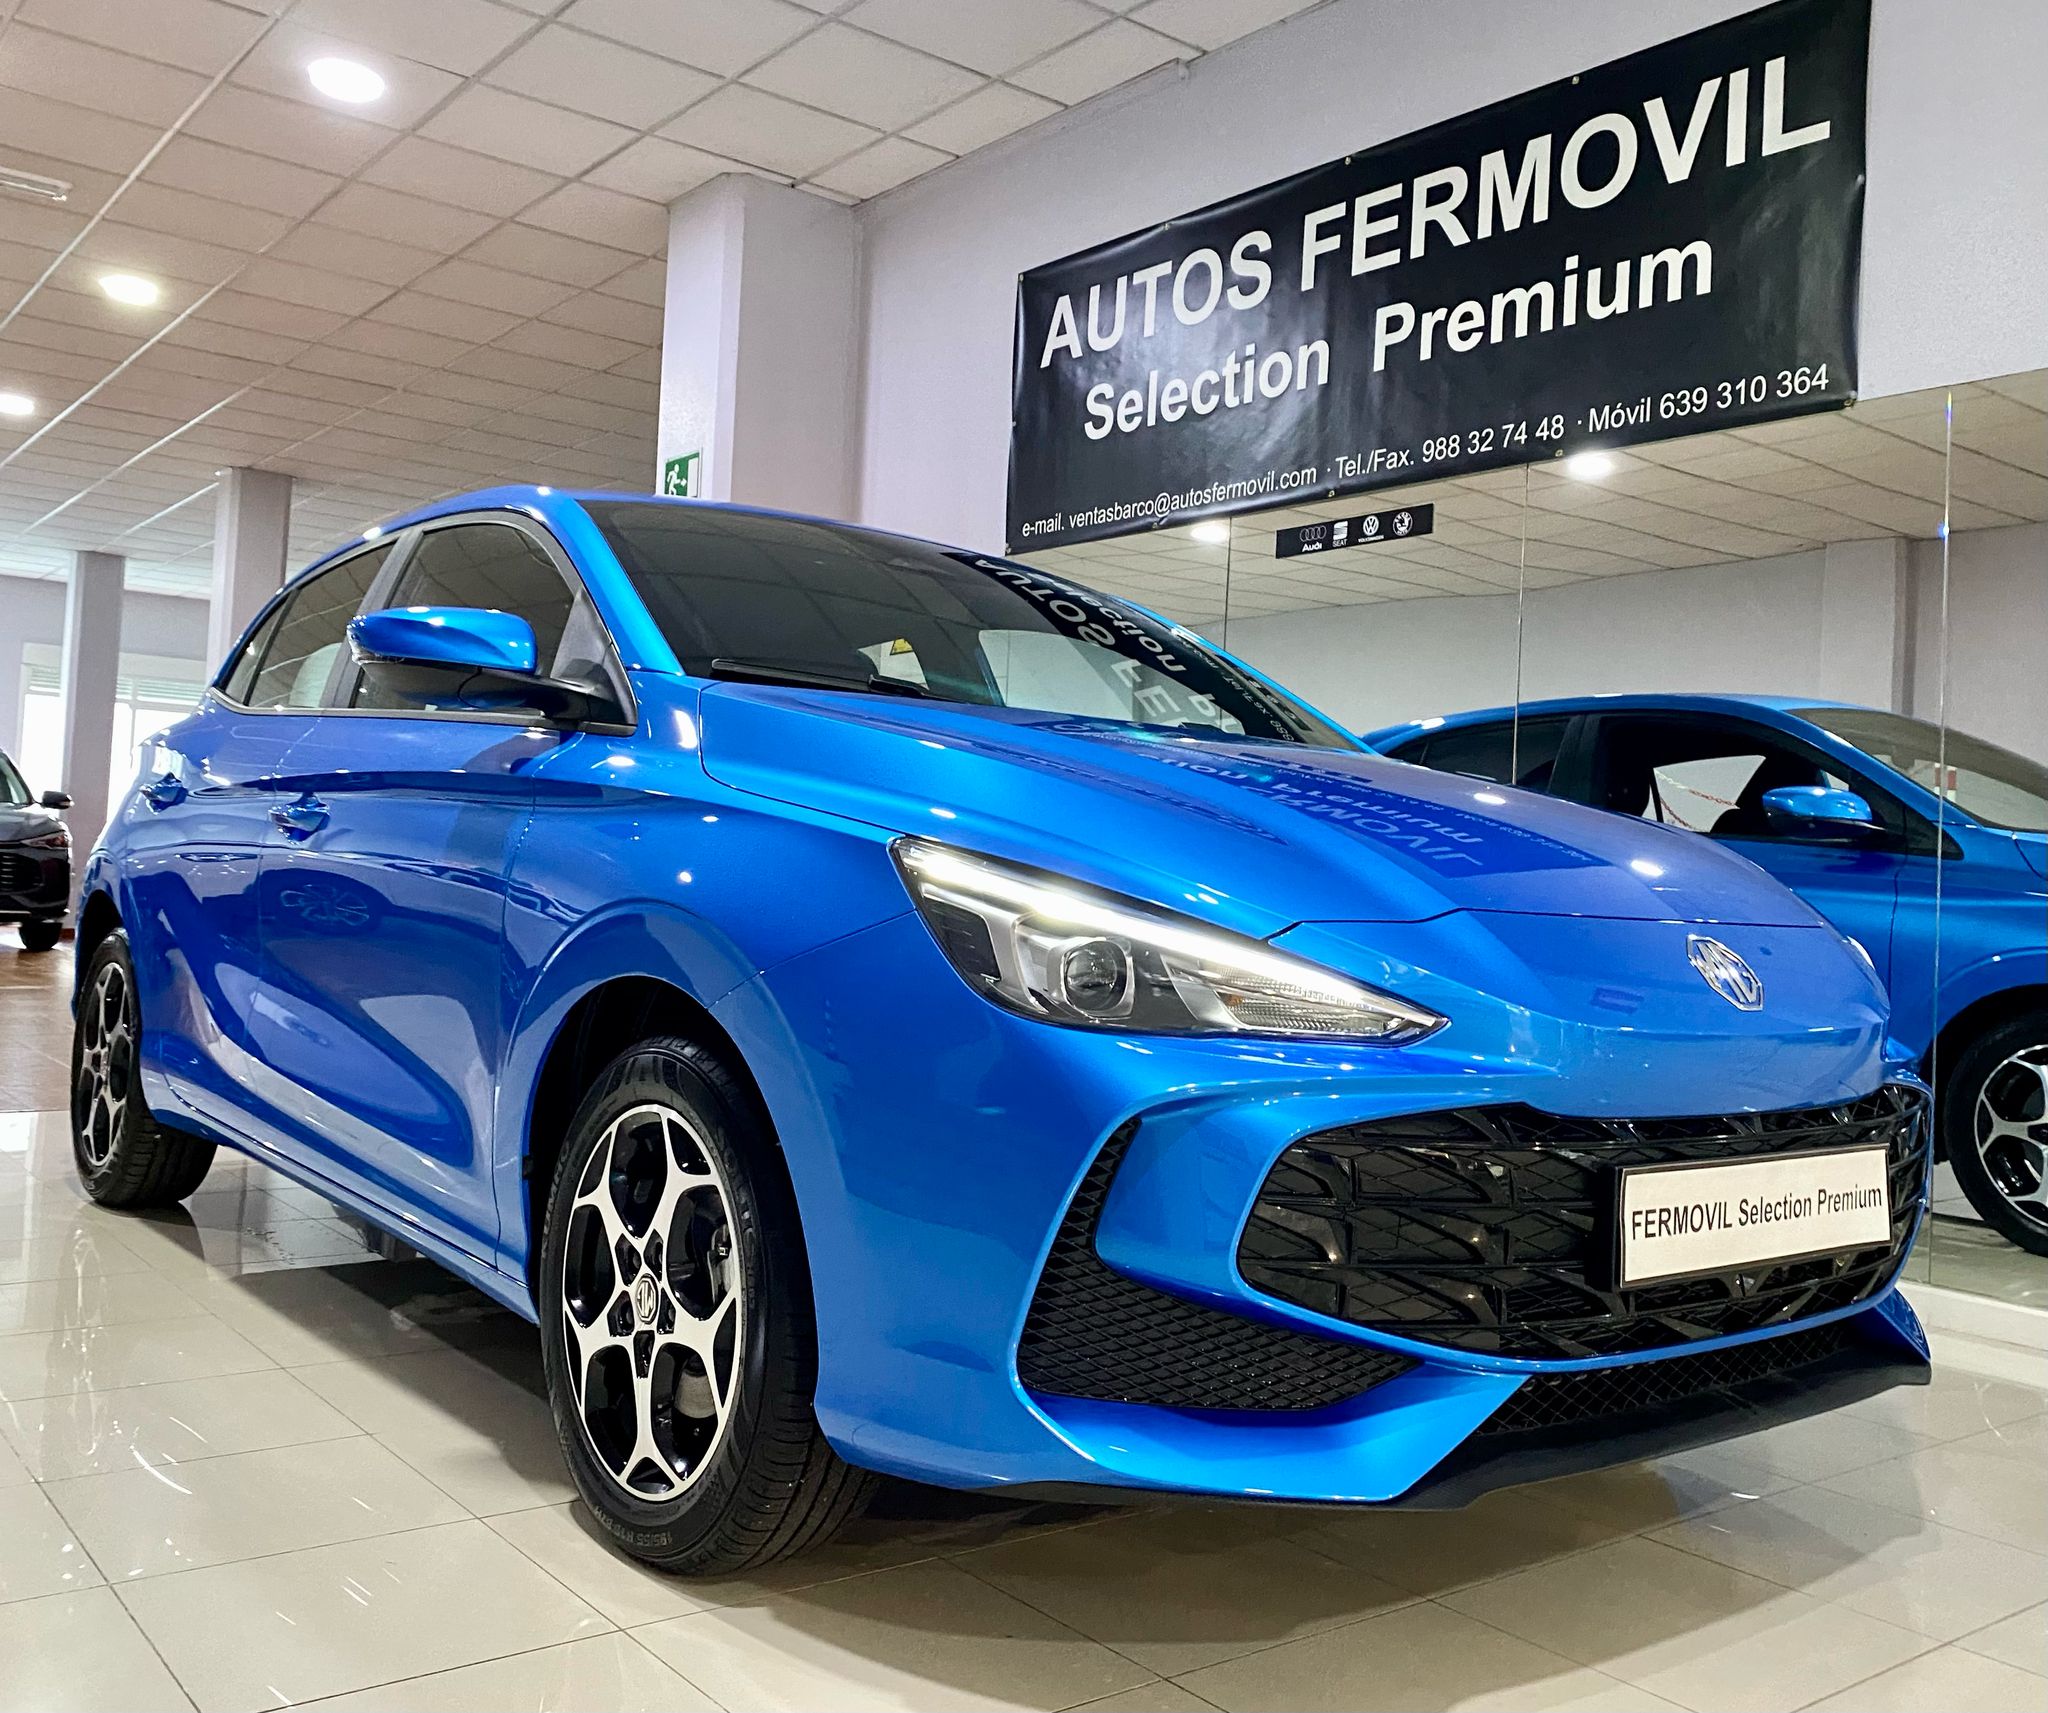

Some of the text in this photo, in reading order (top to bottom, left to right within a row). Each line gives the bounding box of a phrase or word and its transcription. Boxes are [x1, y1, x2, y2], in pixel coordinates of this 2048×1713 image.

[1040, 56, 1831, 369] AUTOS FERMOVIL
[1084, 240, 1712, 440] Selection Premium
[1021, 363, 1830, 538] e-mail. ventasbarco@autosfermovil.com Tel./Fax. 988 32 74 48 Móvil 639 310 364
[1302, 541, 1322, 552] Audi
[1332, 538, 1348, 548] SEAT
[1631, 1184, 1883, 1240] FERMOVIL Selection Premium
